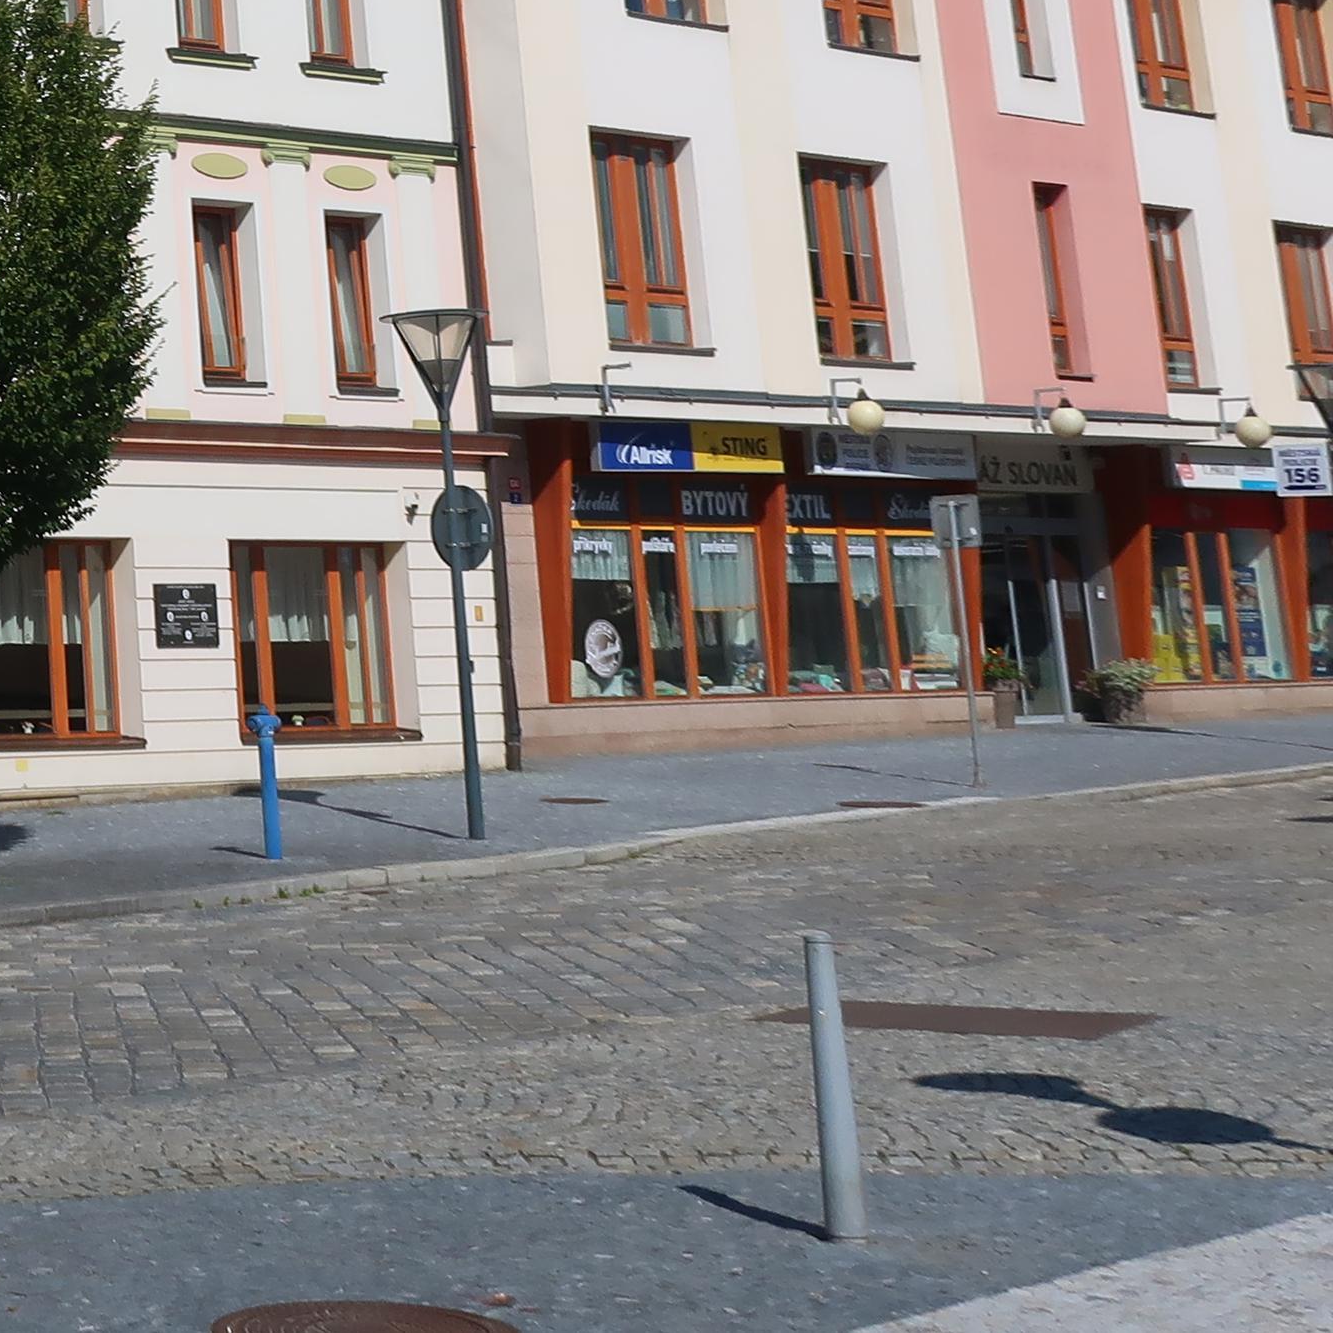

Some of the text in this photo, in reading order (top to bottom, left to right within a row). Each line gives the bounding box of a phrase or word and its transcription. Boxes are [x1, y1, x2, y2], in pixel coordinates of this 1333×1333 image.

[630, 443, 673, 466] Allrisk
[721, 436, 768, 457] STING
[978, 454, 1078, 486] ÁŽ SLOVAN
[1284, 467, 1321, 484] 156
[681, 483, 750, 518] BYTOVÝ
